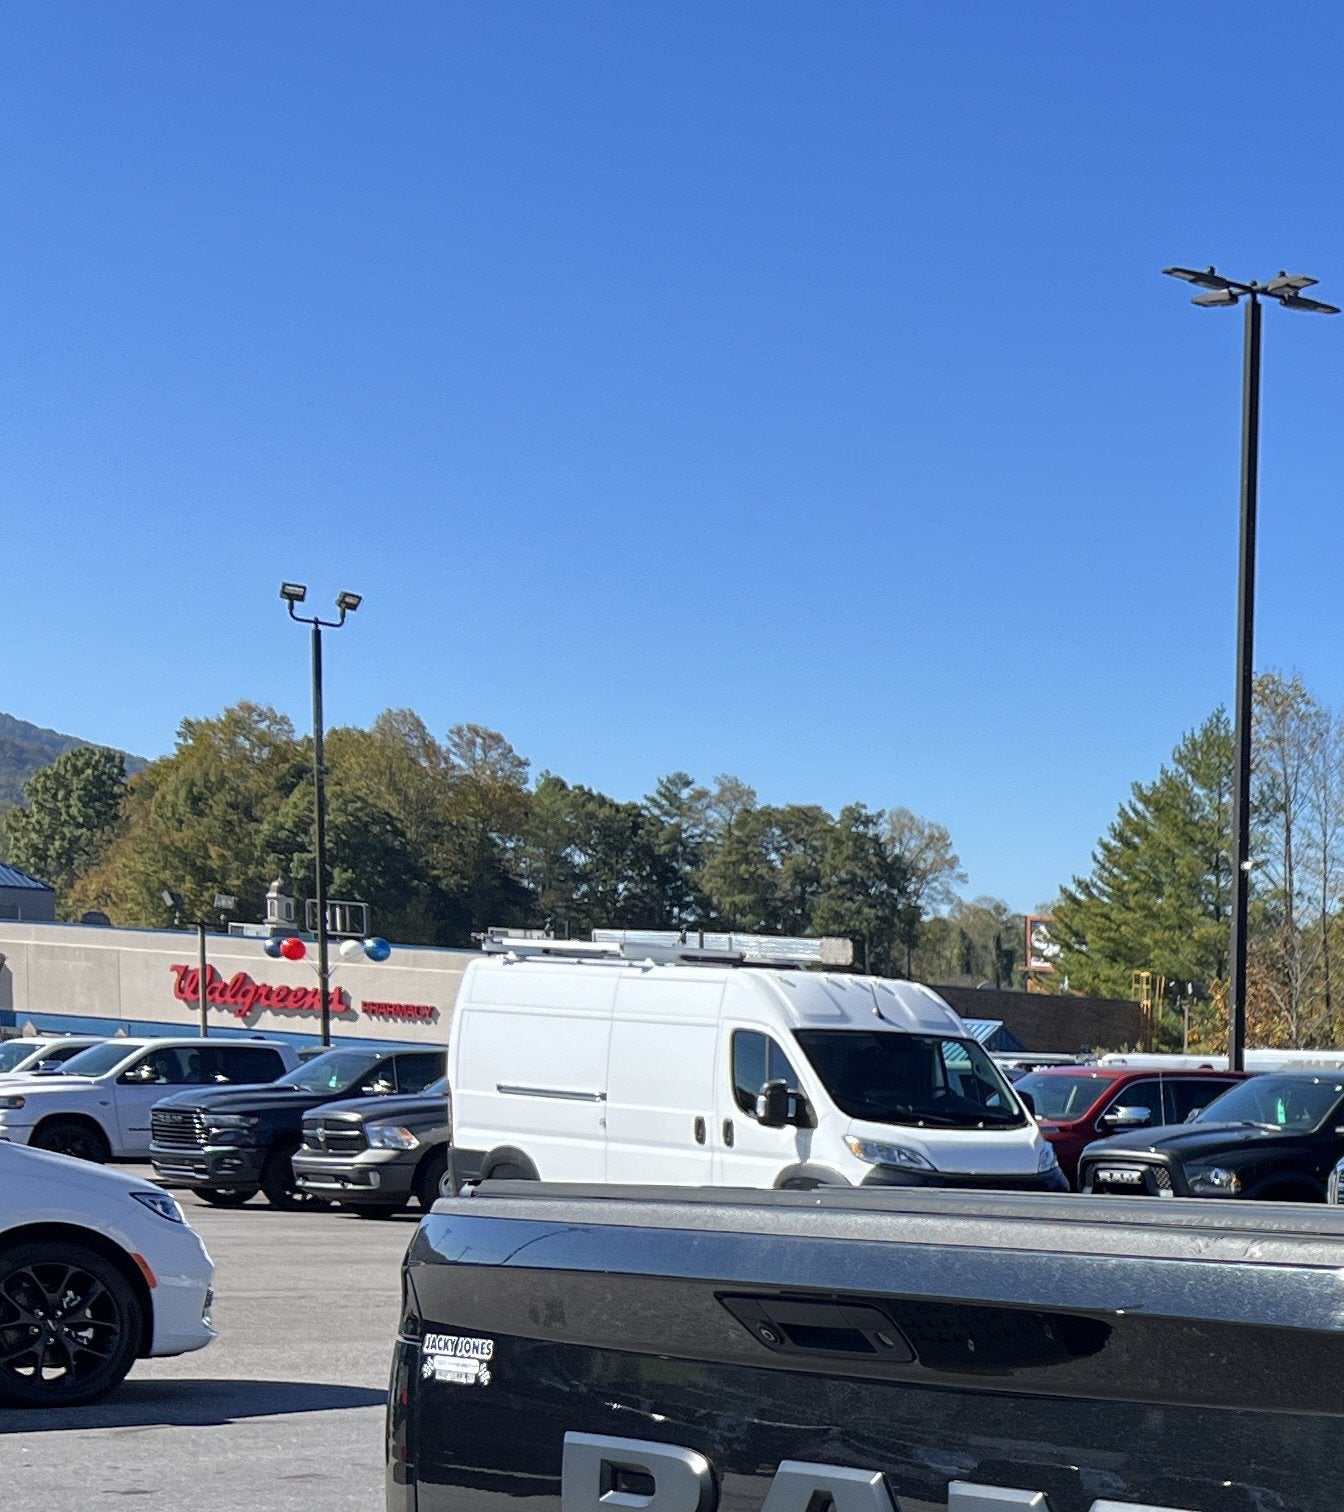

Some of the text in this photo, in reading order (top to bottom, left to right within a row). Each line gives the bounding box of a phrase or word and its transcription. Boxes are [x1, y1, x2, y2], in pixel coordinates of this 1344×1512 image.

[170, 963, 433, 1018] Walgreens PHARMACY
[424, 1333, 494, 1358] JACKY JONES
